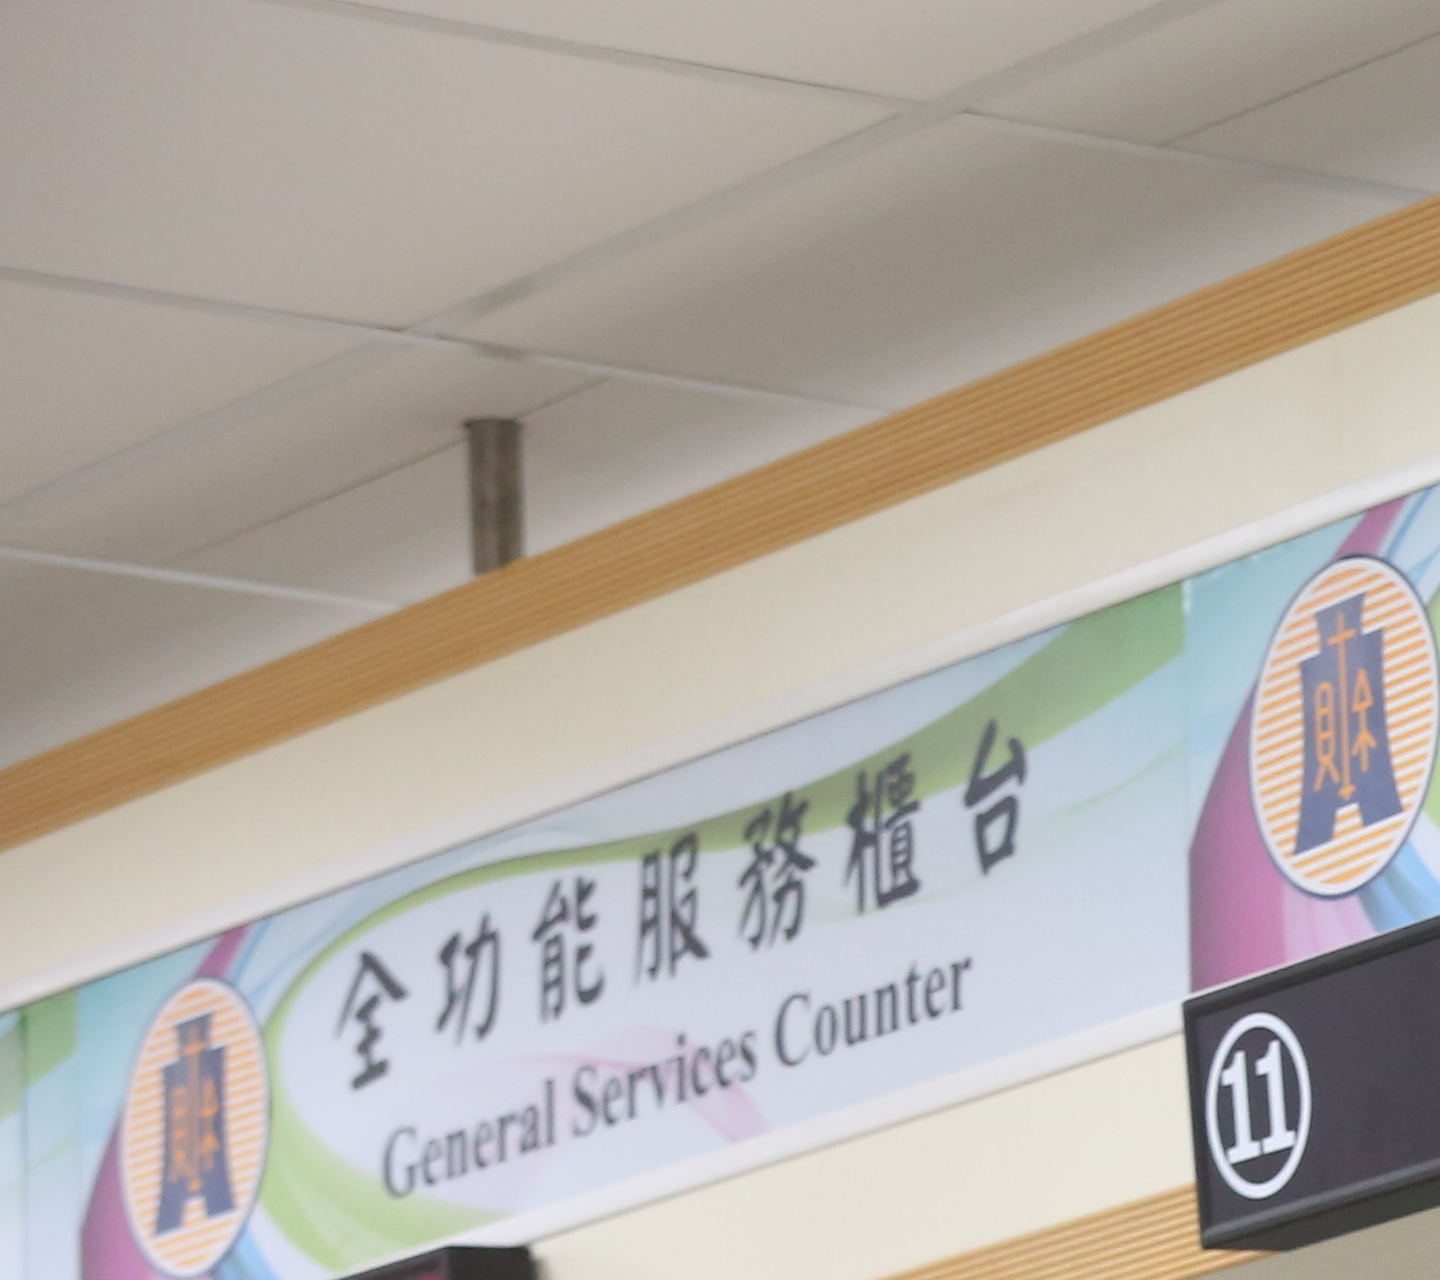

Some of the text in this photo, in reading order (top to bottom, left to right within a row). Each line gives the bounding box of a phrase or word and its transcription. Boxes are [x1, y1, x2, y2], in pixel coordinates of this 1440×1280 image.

[335, 716, 1028, 1091] 全功能服務櫃台
[383, 957, 974, 1199] General Services Counter
[1220, 1039, 1297, 1165] 11
